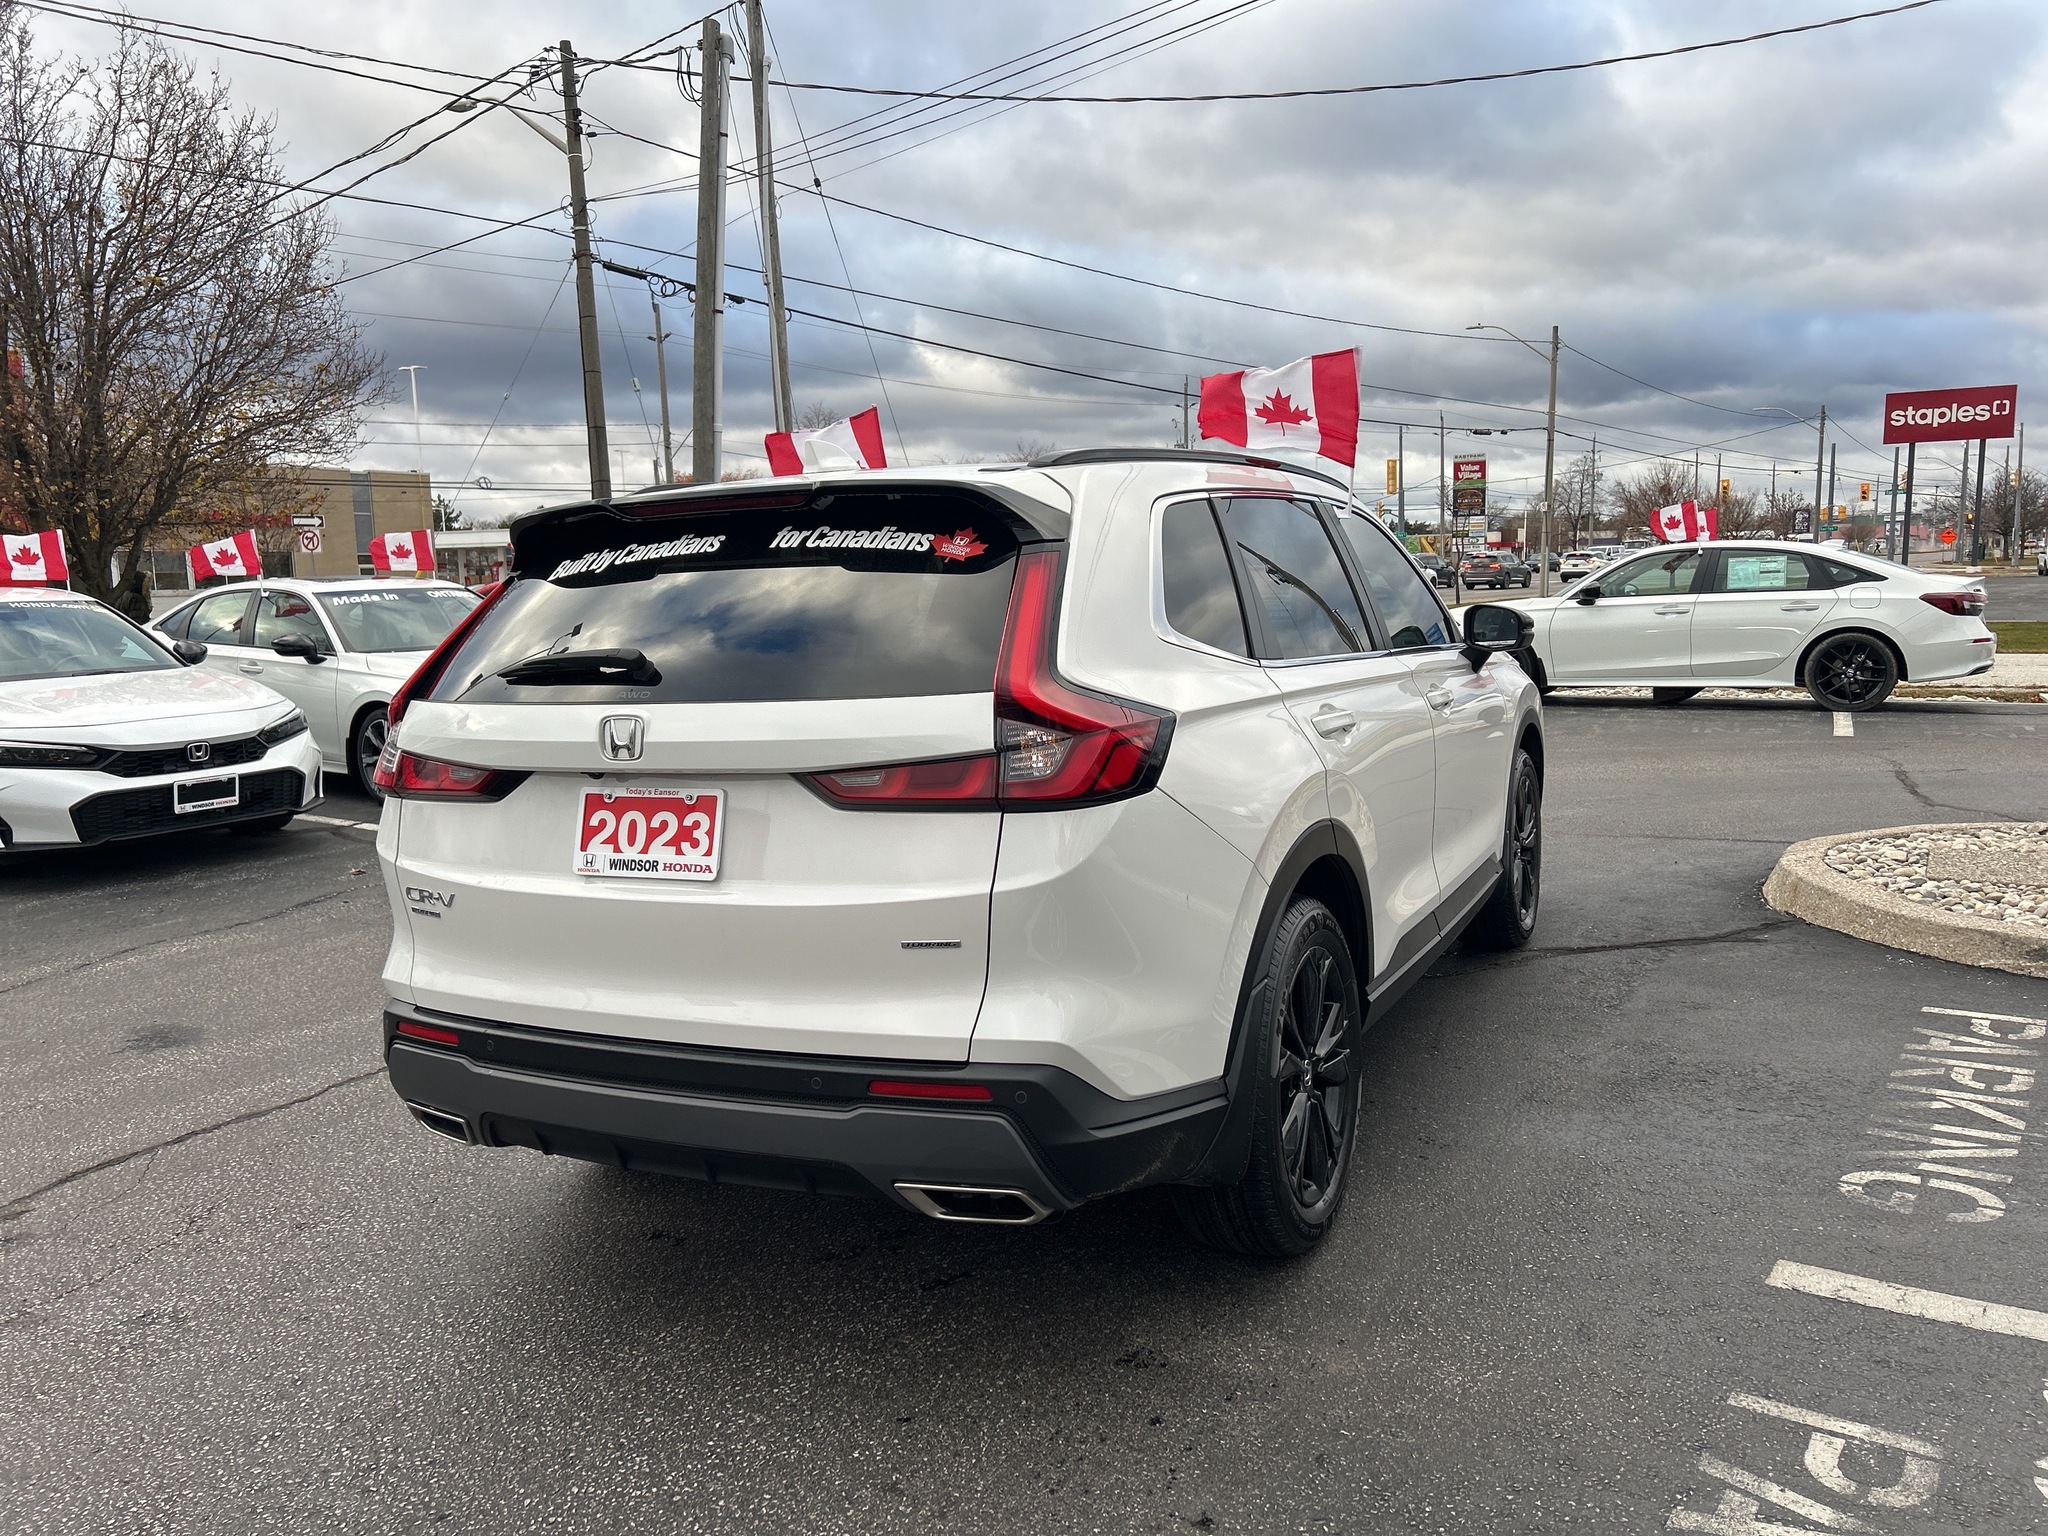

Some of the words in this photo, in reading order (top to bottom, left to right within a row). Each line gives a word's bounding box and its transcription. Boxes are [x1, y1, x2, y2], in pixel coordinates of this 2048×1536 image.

[1890, 403, 1991, 427] staples
[1460, 463, 1480, 471] Value
[1457, 471, 1482, 480] Village
[769, 526, 813, 548] for
[806, 526, 935, 551] Canadians
[941, 547, 966, 556] HONDA
[942, 542, 971, 553] WINDSOR
[547, 552, 600, 581] Built
[592, 548, 622, 574] by
[614, 534, 727, 565] Canadians
[332, 593, 381, 606] Made
[615, 691, 651, 699] AWD
[625, 788, 652, 797] Today's
[192, 802, 215, 810] WINDSOR
[586, 809, 711, 856] 2023
[609, 858, 659, 873] WINDSOR
[662, 862, 713, 874] HONDA
[405, 886, 456, 908] CR-V
[1837, 1006, 2047, 1223] PARKING
